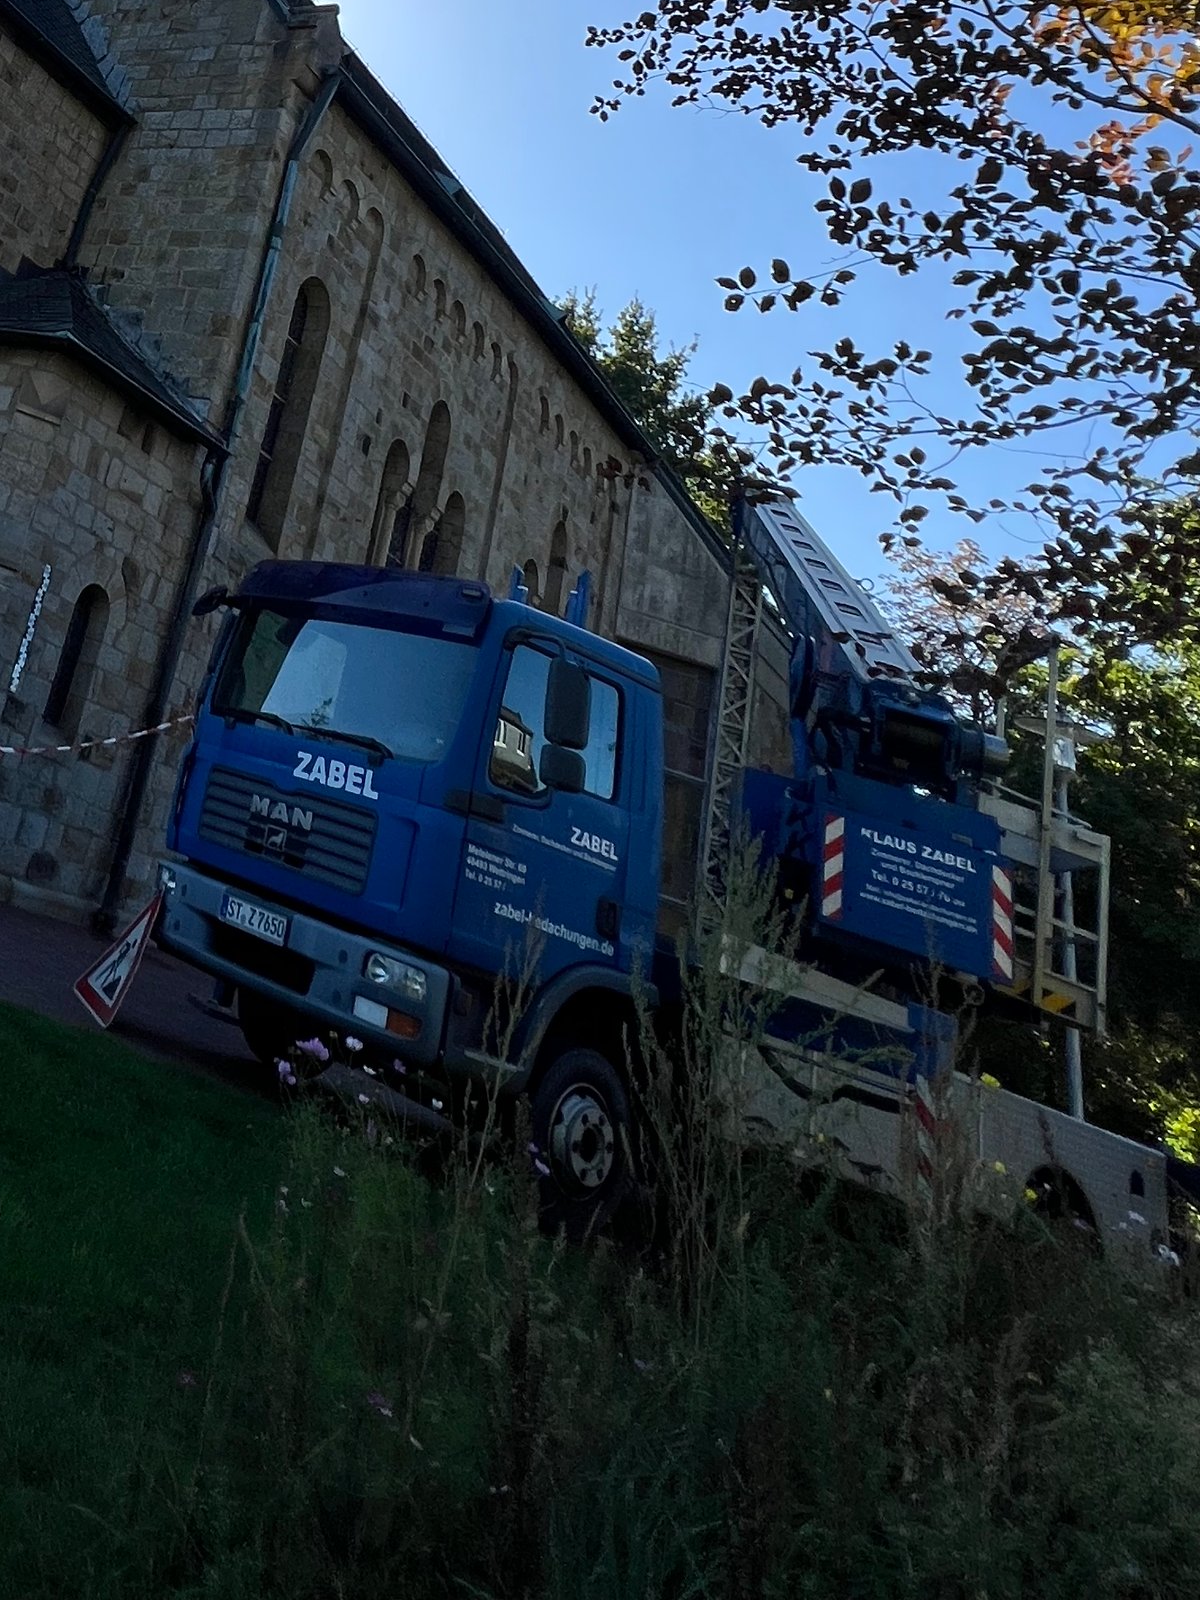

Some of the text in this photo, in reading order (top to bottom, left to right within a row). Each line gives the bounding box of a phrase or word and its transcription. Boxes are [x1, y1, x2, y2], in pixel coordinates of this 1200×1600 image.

[293, 751, 379, 800] ZABEL
[250, 794, 313, 831] MAN
[571, 825, 619, 862] ZABEL
[860, 827, 977, 874] KLAUS ZABEL
[227, 900, 243, 919] ST
